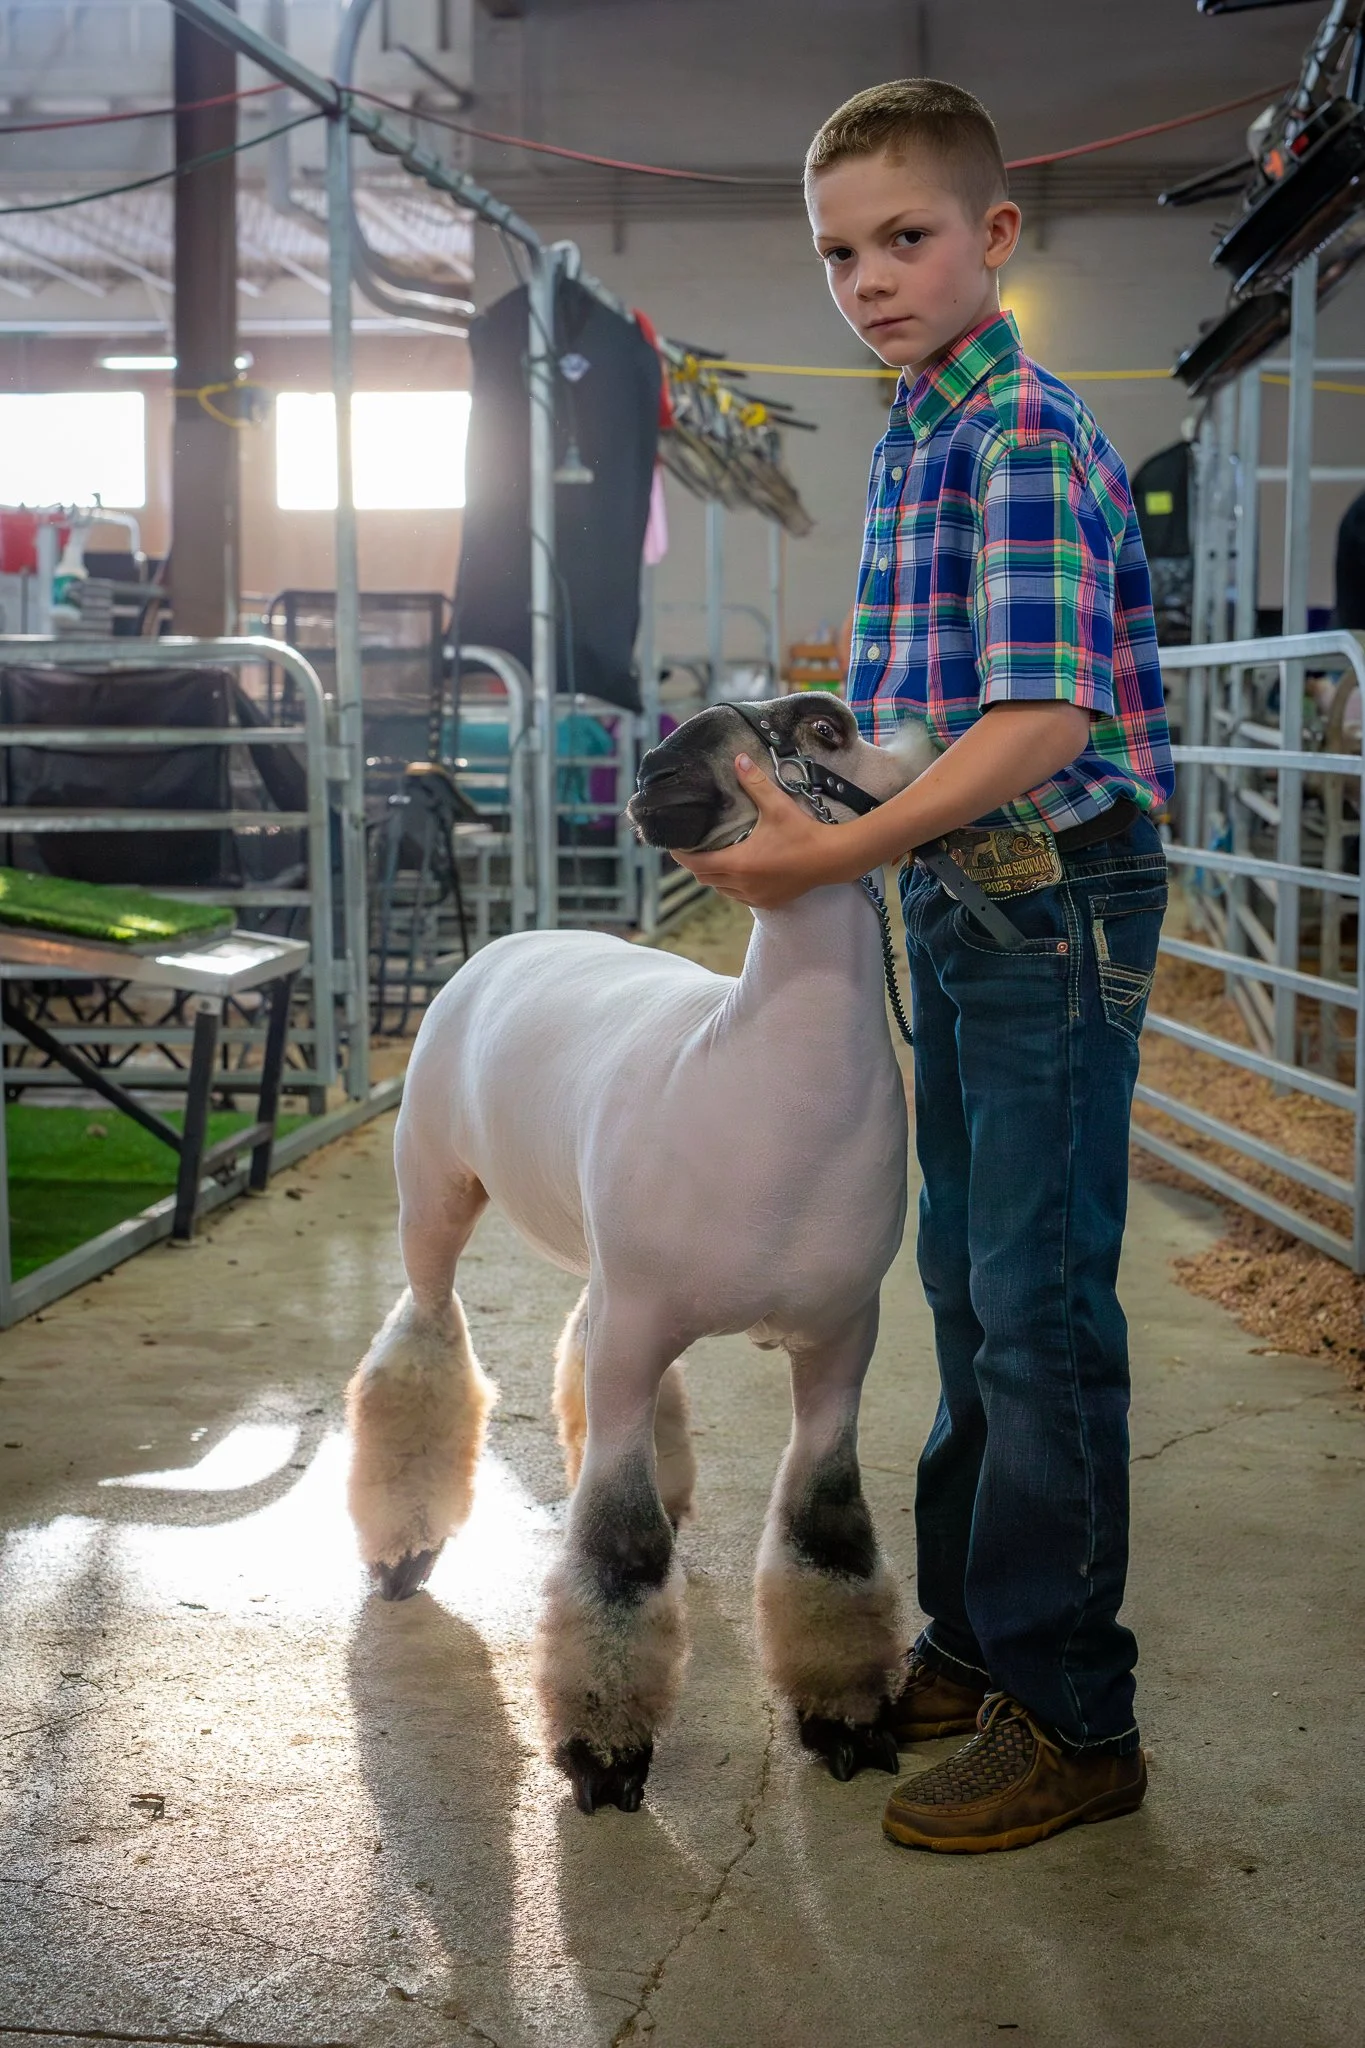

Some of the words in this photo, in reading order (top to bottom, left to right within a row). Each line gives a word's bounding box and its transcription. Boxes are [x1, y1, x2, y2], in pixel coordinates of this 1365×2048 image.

[993, 863, 1013, 878] LAMB
[1013, 852, 1052, 876] SHOWMAN
[985, 880, 1012, 893] 2025
